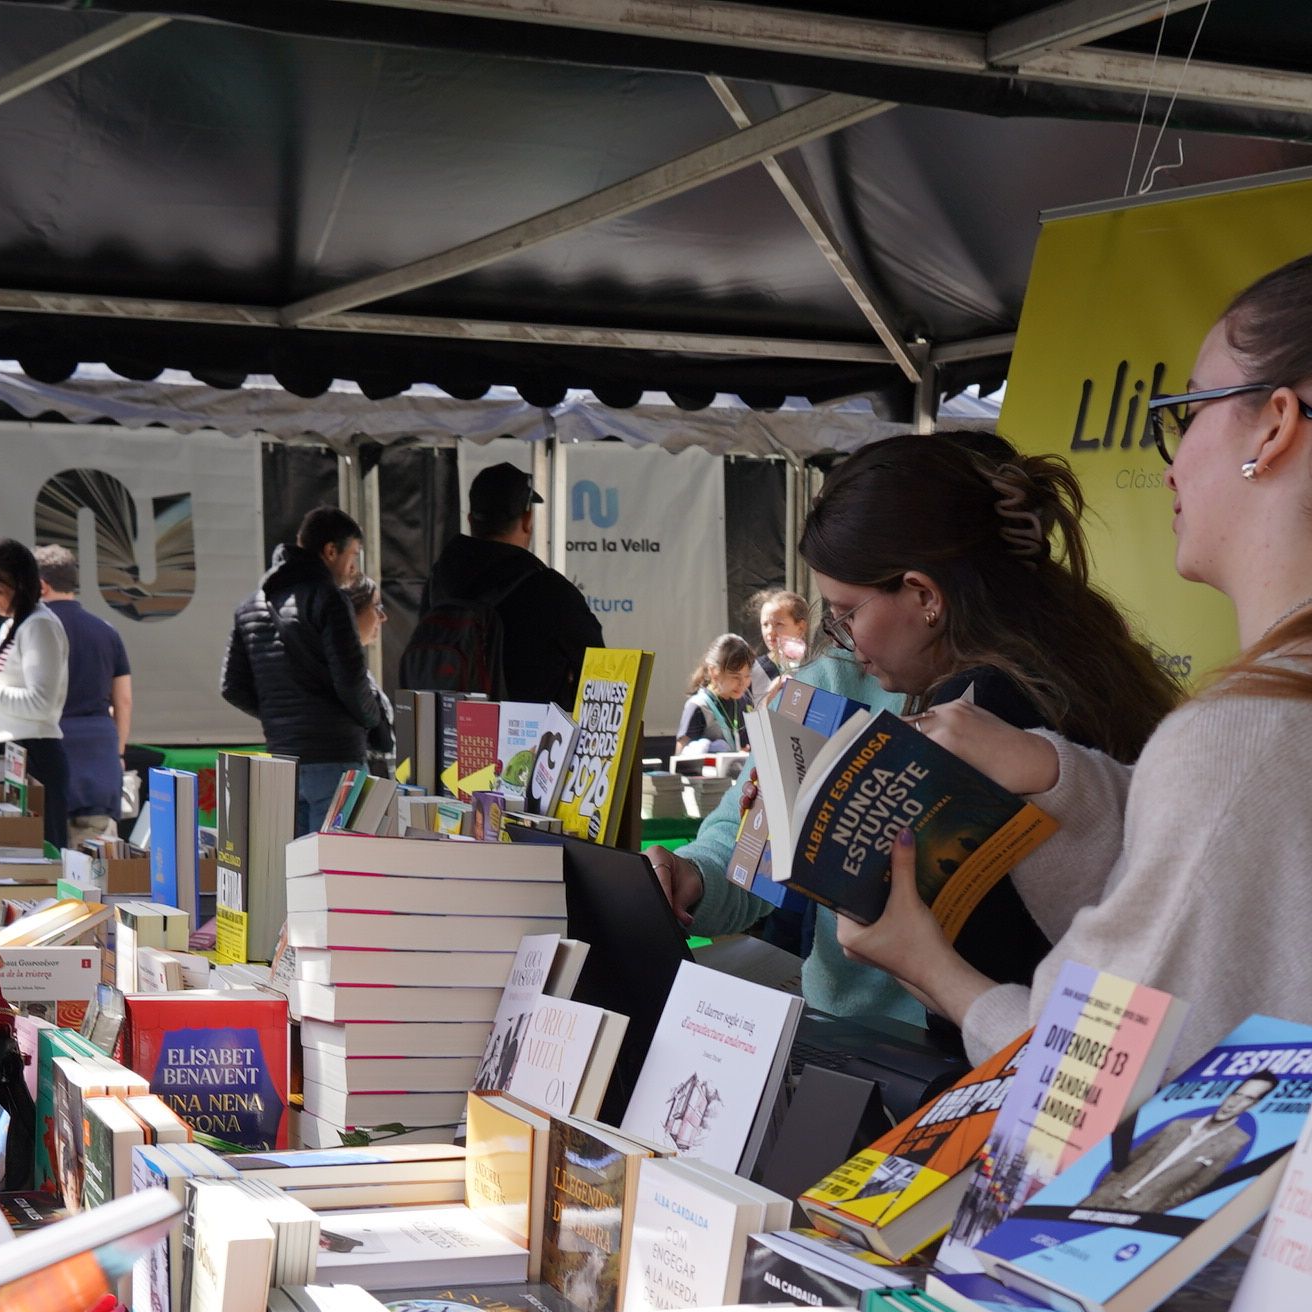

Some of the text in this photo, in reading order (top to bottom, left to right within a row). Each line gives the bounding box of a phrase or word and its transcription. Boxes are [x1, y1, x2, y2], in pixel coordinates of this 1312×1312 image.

[602, 537, 661, 553] la Vella
[583, 679, 630, 701] GUINNESS
[579, 702, 626, 734] WORLD
[576, 732, 619, 758] ECORDS
[560, 757, 614, 818] 2026
[804, 731, 893, 865] ALBERT ESPINOSA
[831, 765, 895, 847] NUNCA
[841, 760, 930, 878] ESTUVISTE
[874, 798, 925, 856] SOLO
[534, 1006, 579, 1042] ORIOL
[696, 1000, 706, 1014] El
[703, 1003, 725, 1021] darrer
[1043, 1023, 1130, 1078] DIVENDRES 13
[162, 1066, 260, 1086] BENAVENT
[1039, 1064, 1055, 1086] LA
[1051, 1069, 1104, 1108] PANDÈMIA
[208, 1091, 266, 1113] NENA
[1040, 1095, 1088, 1131] ANDORRA
[663, 1224, 690, 1251] COM
[651, 1244, 697, 1280] ENGEGAR
[652, 1266, 667, 1286] LA
[665, 1276, 699, 1306] MERDA
[764, 1271, 824, 1308] ALBA CARDALDA
